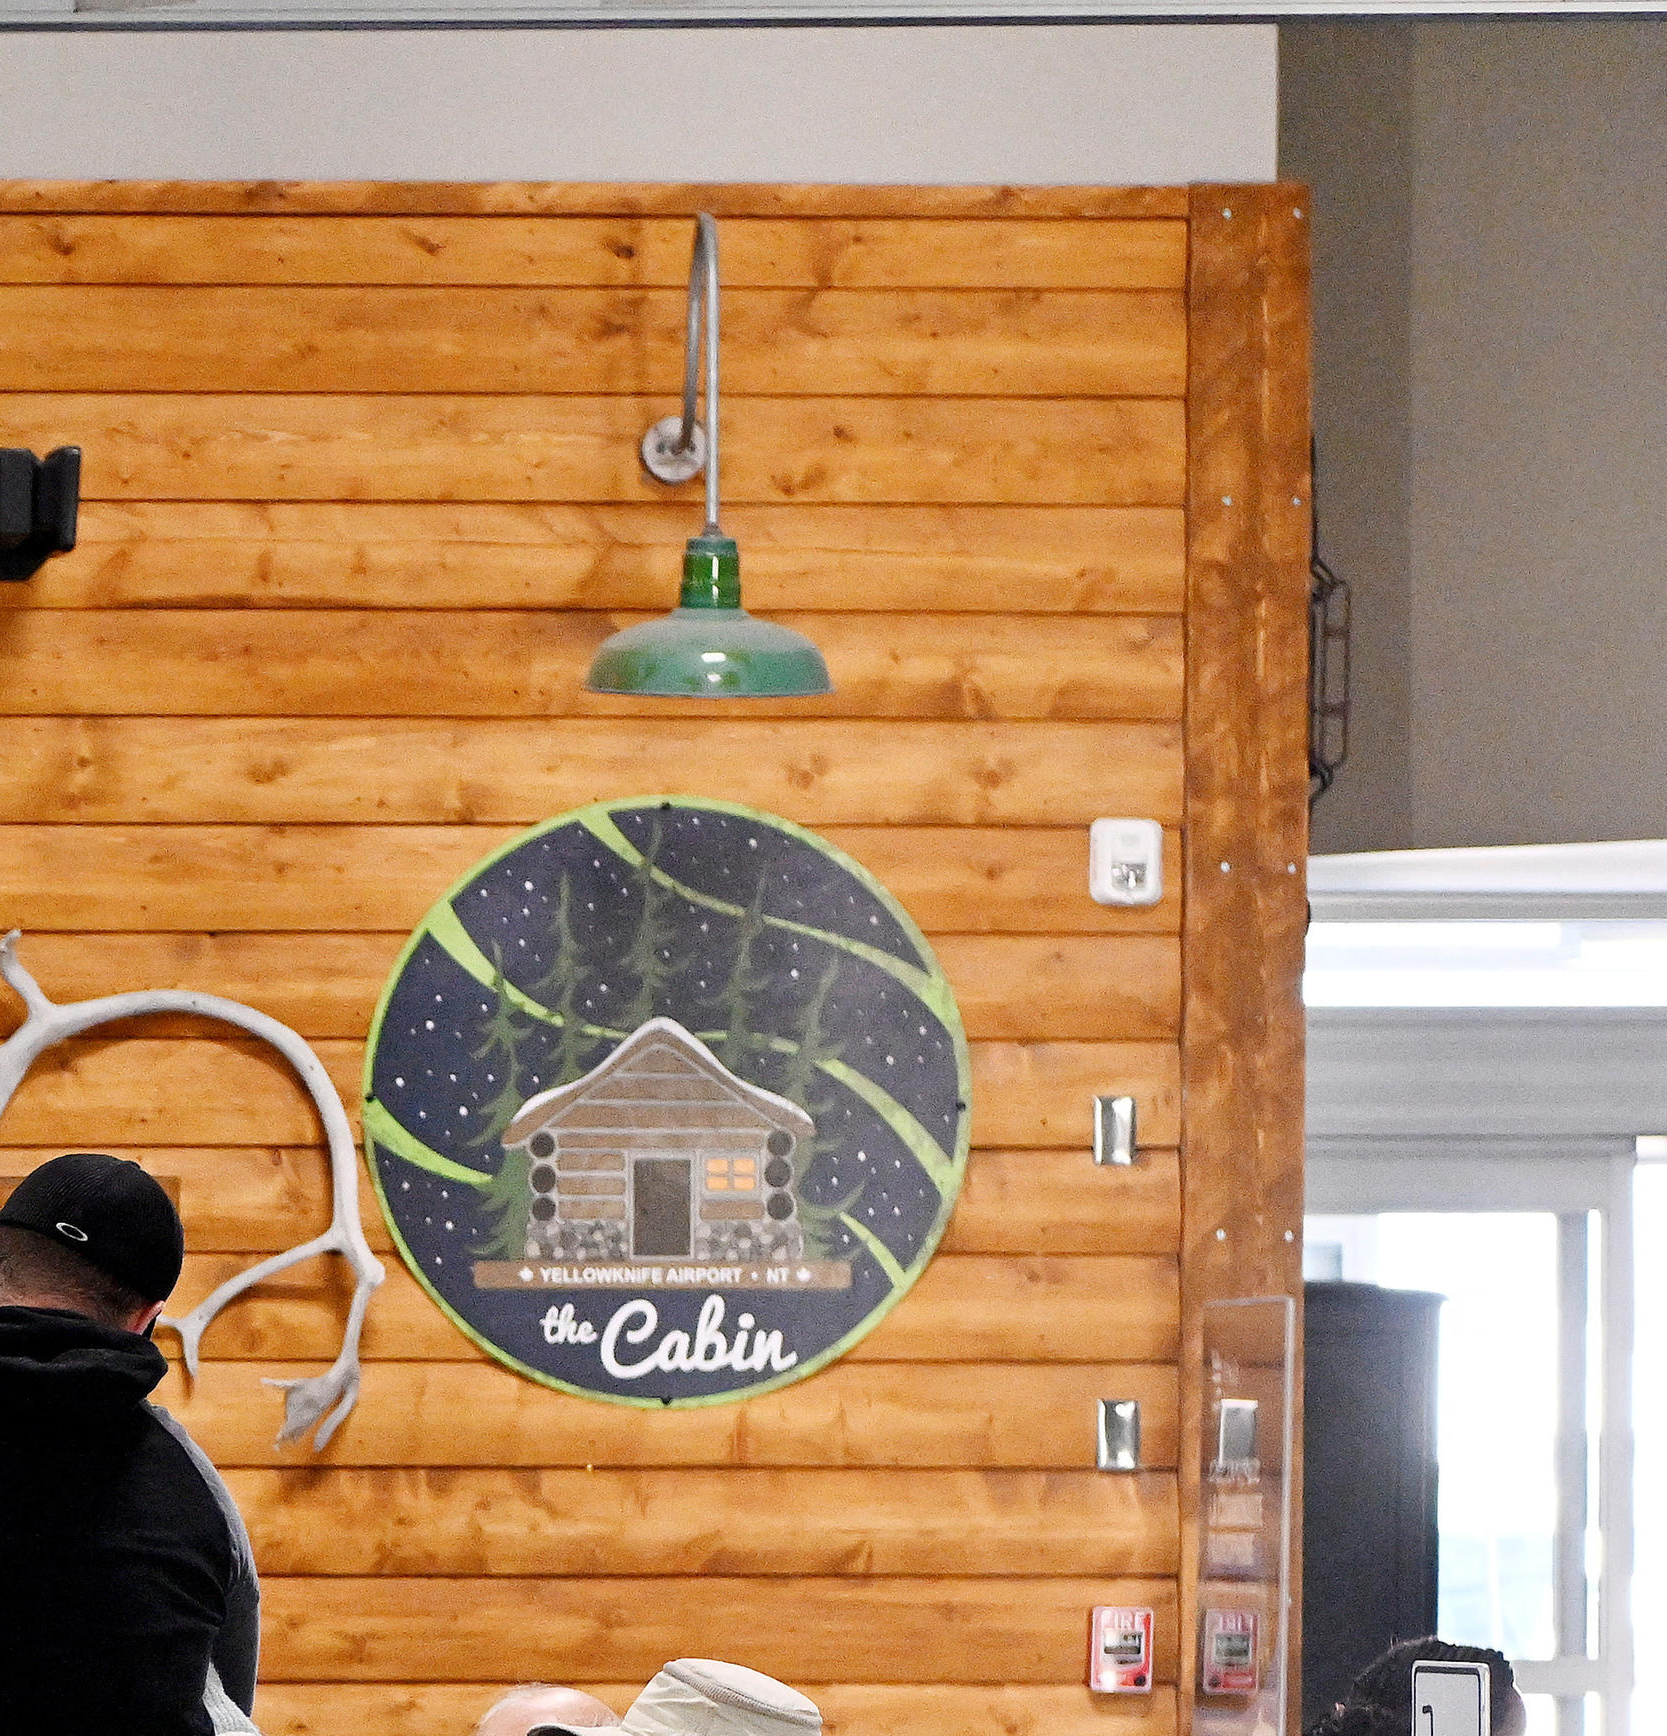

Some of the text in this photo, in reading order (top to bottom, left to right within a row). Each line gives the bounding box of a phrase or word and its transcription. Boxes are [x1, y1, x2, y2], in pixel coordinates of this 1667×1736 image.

[539, 1266, 789, 1284] YELLOWKNIFE AIRPORT NT
[540, 1294, 798, 1379] the Cabin
[1100, 1610, 1146, 1632] FIRE
